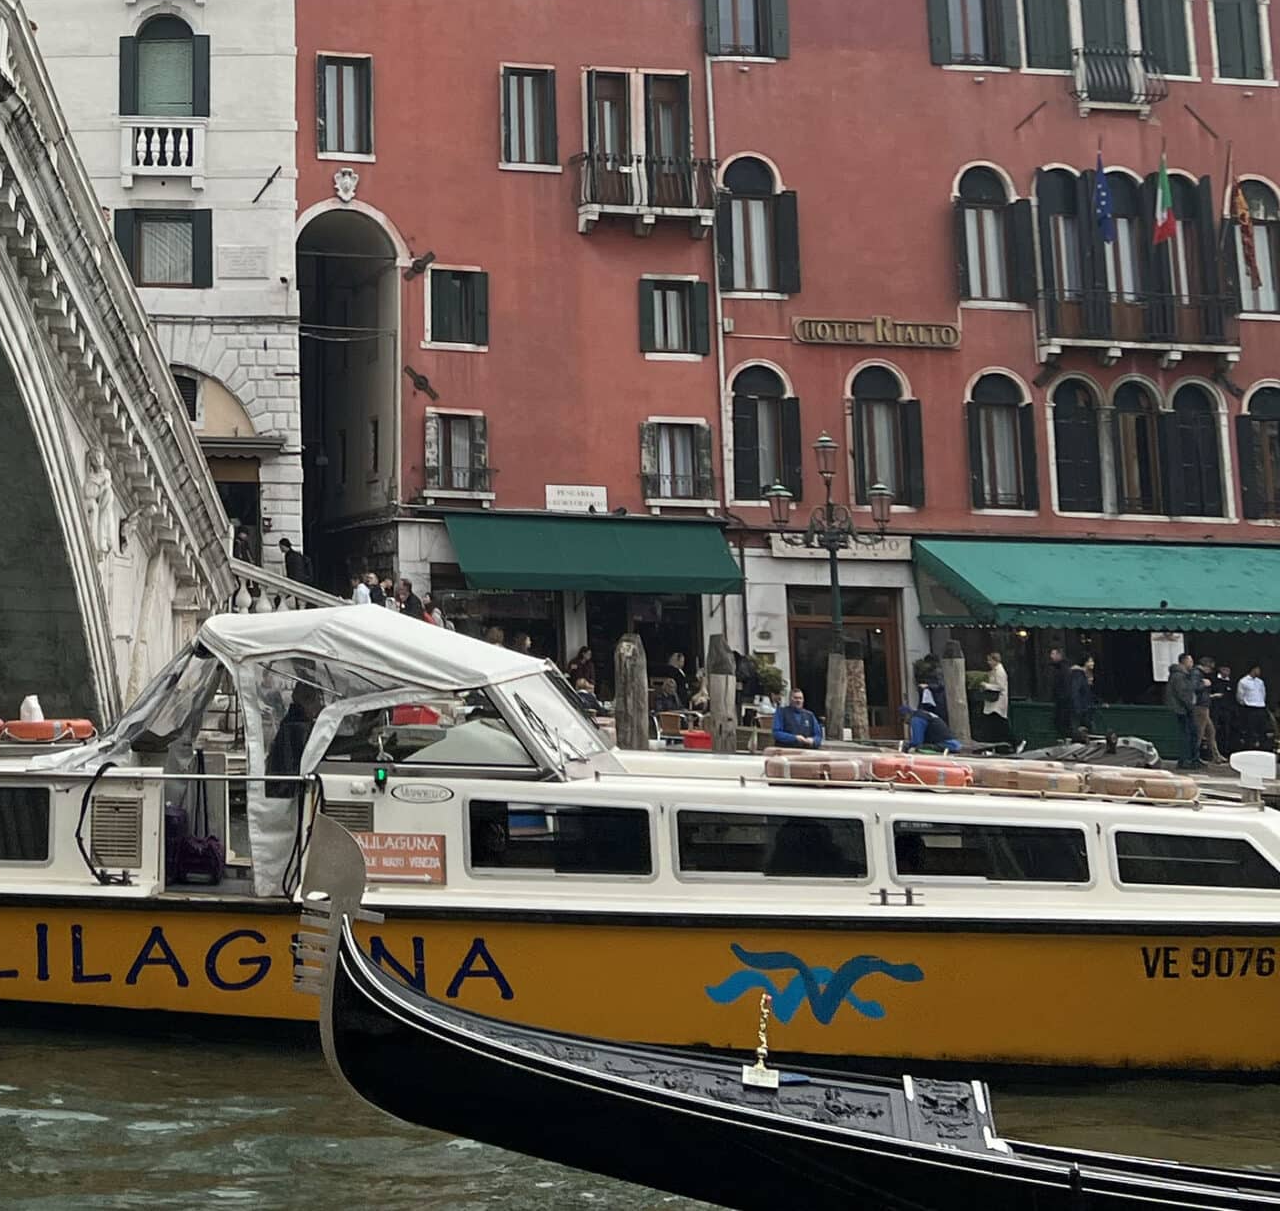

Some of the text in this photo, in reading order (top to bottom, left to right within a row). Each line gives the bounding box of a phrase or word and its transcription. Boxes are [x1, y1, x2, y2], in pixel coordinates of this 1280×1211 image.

[804, 316, 956, 345] HOTEL RIALTO
[1140, 946, 1276, 979] VE 9076
